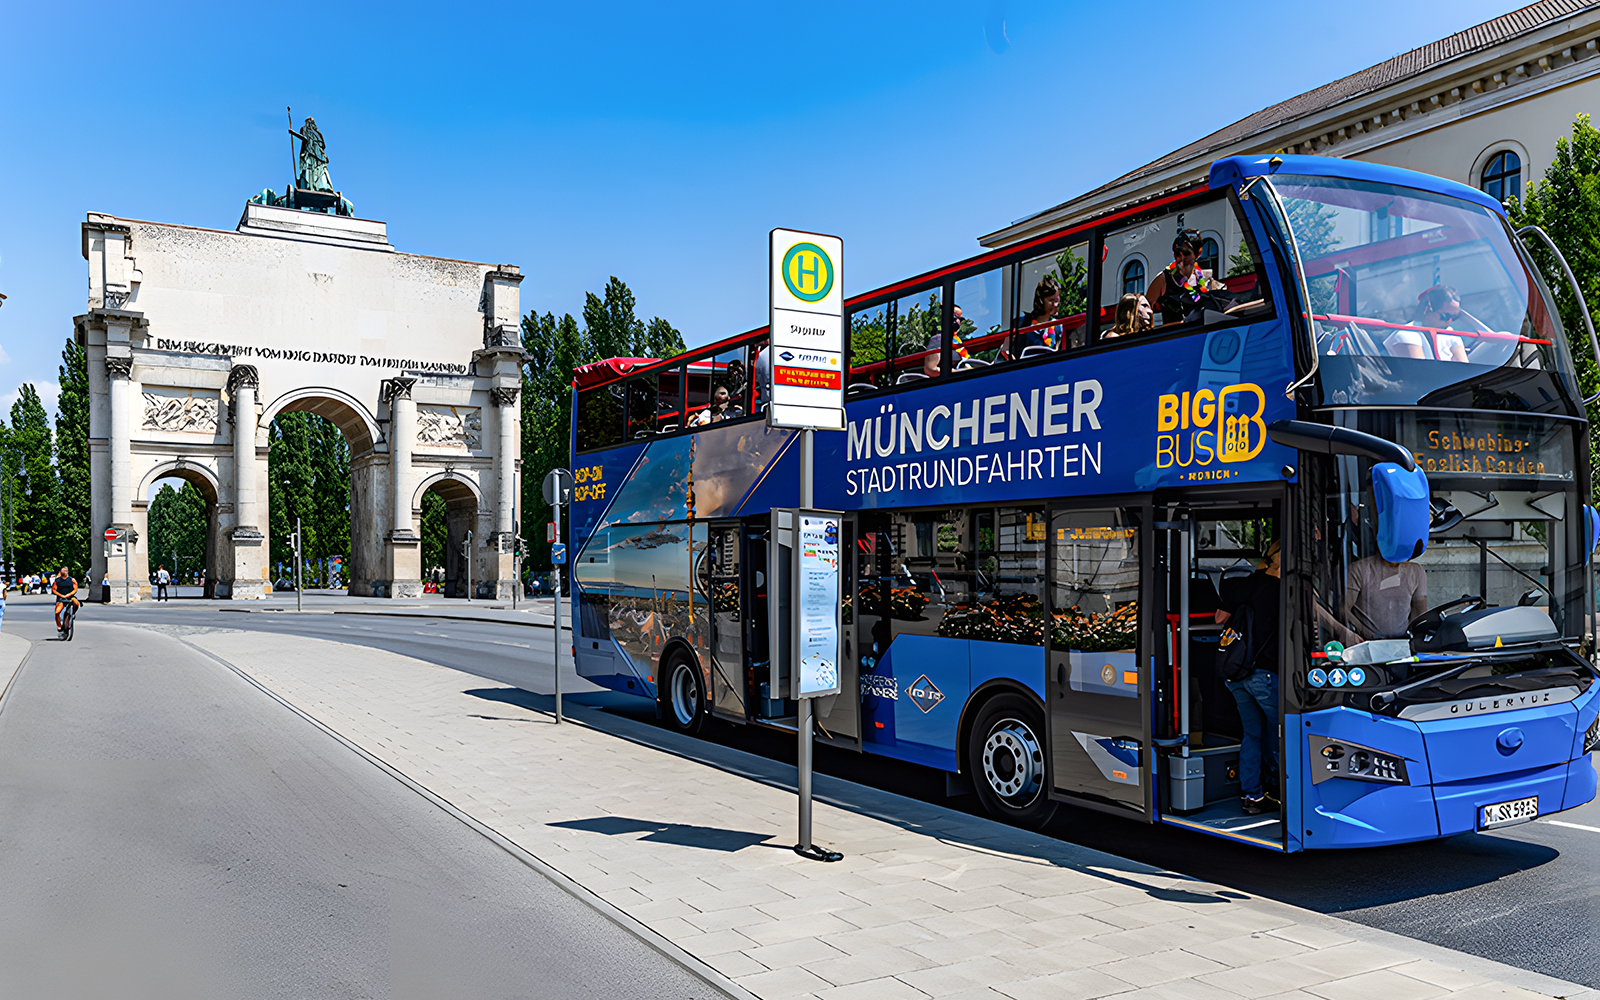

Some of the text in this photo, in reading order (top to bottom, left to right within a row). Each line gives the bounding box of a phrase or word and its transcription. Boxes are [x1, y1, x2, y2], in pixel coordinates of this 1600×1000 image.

[798, 255, 819, 290] H
[847, 379, 1104, 462] MÜNCHENER
[1157, 388, 1216, 432] BIG
[846, 441, 1103, 497] STADTRUNDFAHRTEN
[1156, 430, 1215, 469] BUS
